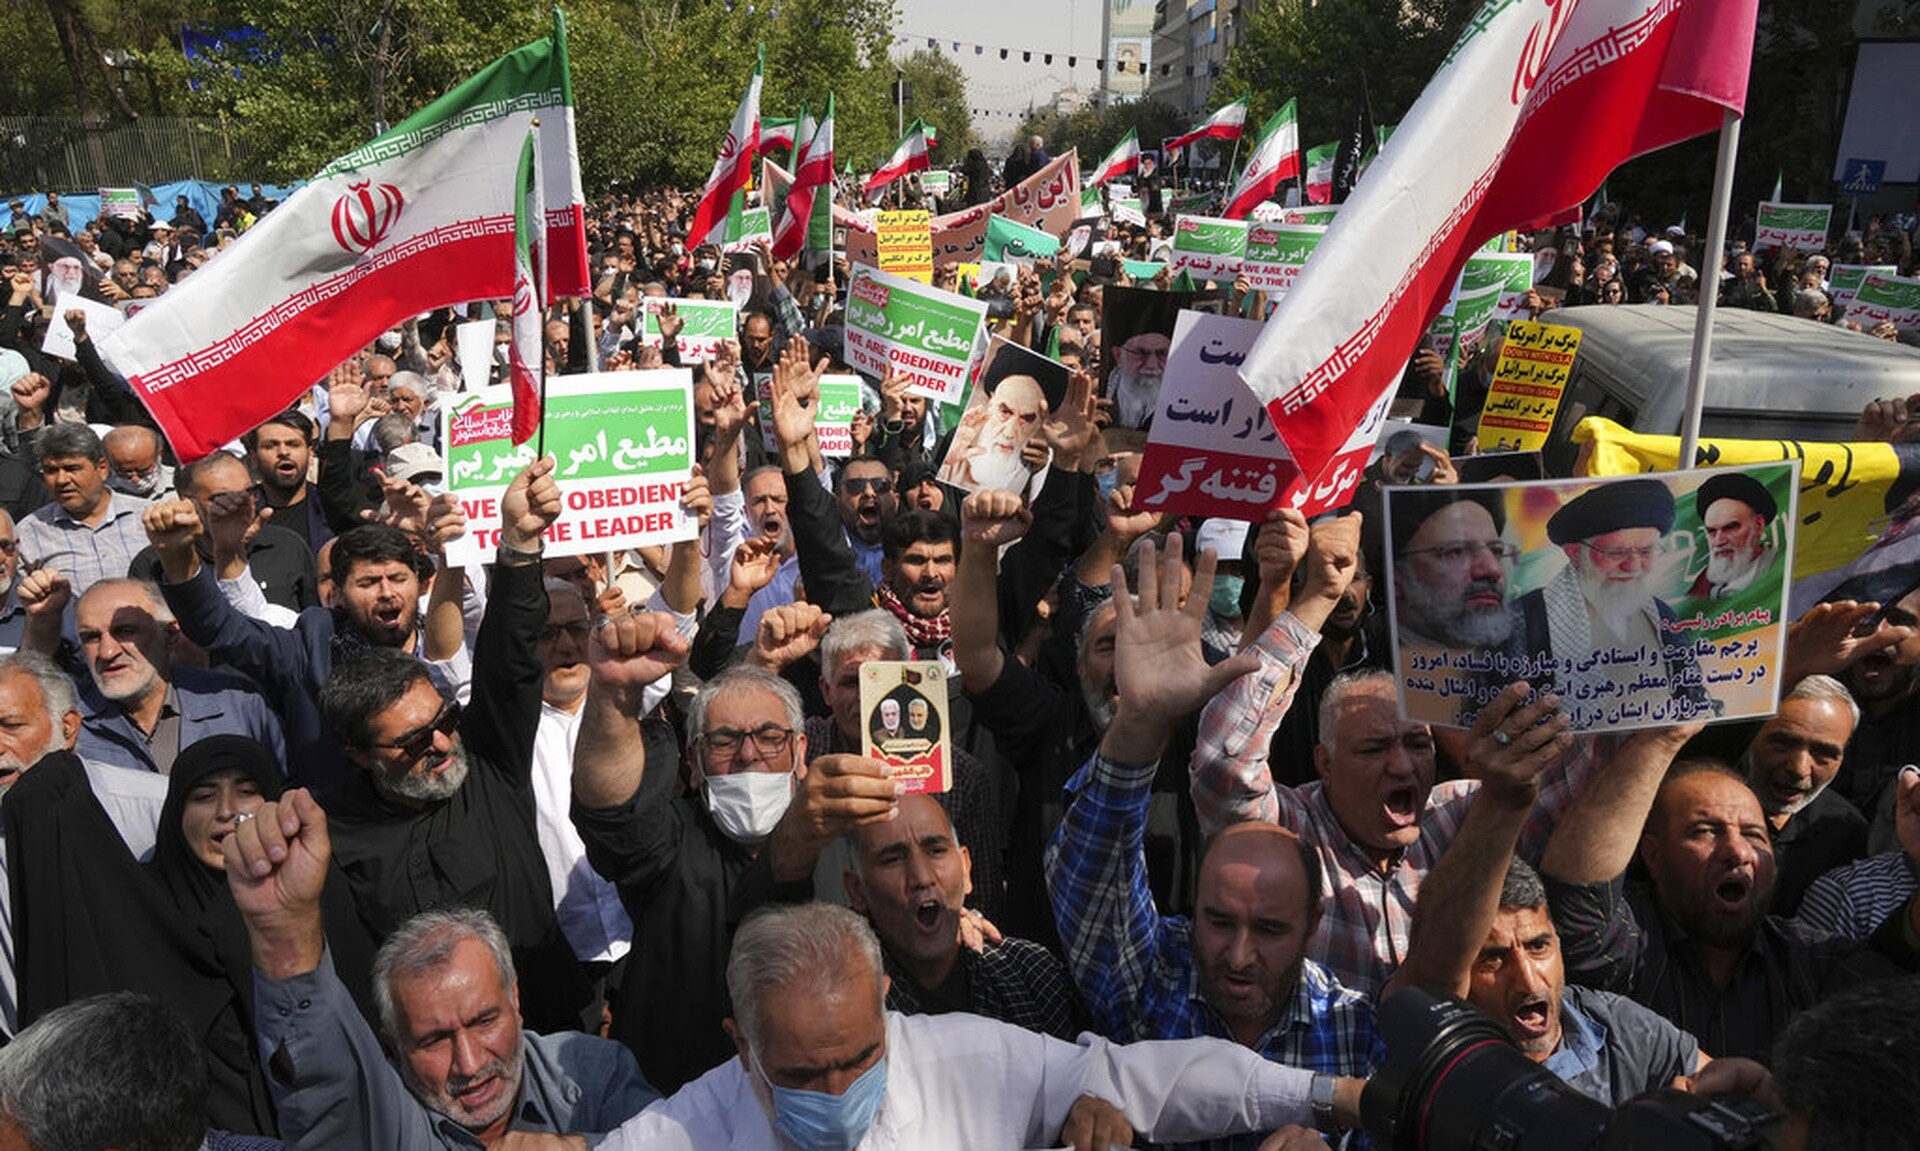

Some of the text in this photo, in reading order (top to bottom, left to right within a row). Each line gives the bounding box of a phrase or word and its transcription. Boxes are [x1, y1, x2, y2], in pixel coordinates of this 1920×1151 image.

[912, 214, 928, 224] مرگ
[1801, 232, 1824, 244] مرگ
[1214, 262, 1226, 275] بر
[1245, 264, 1260, 274] WE
[1263, 266, 1281, 276] ARE
[1266, 278, 1285, 287] THE
[1498, 297, 1522, 313] رگ
[849, 305, 894, 335] رهبریم
[893, 320, 925, 339] امر
[922, 328, 971, 352] مطیع
[1509, 324, 1577, 352] مرگ بر آمریکا
[847, 330, 964, 378] WE ARE OBEDIENT
[853, 350, 867, 364] TO
[1497, 360, 1565, 385] مرگ بر اسرائیل
[1166, 398, 1233, 427] است
[1520, 405, 1531, 416] بر
[1533, 403, 1554, 418] مرگ
[562, 430, 608, 475] امر
[612, 424, 687, 471] مطیع
[1314, 459, 1358, 507] مرگ
[567, 481, 687, 511] OBEDIENT
[541, 522, 572, 543] HE
[580, 512, 674, 541] LEADER
[1713, 611, 1745, 629] برادر
[1746, 609, 1771, 624] پیام
[1576, 645, 1645, 673] ایستادگی
[1649, 650, 1658, 667] و
[1662, 640, 1716, 663] مقاومت
[1720, 638, 1759, 660] پرچم
[1411, 652, 1448, 670] امروز
[1494, 652, 1509, 677] با
[1511, 650, 1559, 677] مبارزه
[1565, 656, 1573, 674] و
[1628, 672, 1668, 695] معظم
[1671, 667, 1703, 692] مقام
[1706, 666, 1743, 684] دست
[1746, 663, 1766, 685] در
[1439, 678, 1474, 698] امثال
[1478, 687, 1487, 703] و
[1576, 679, 1624, 700] رهبری
[1587, 707, 1604, 727] در
[1607, 701, 1649, 725] ایشان
[1652, 695, 1711, 721] سربازان
